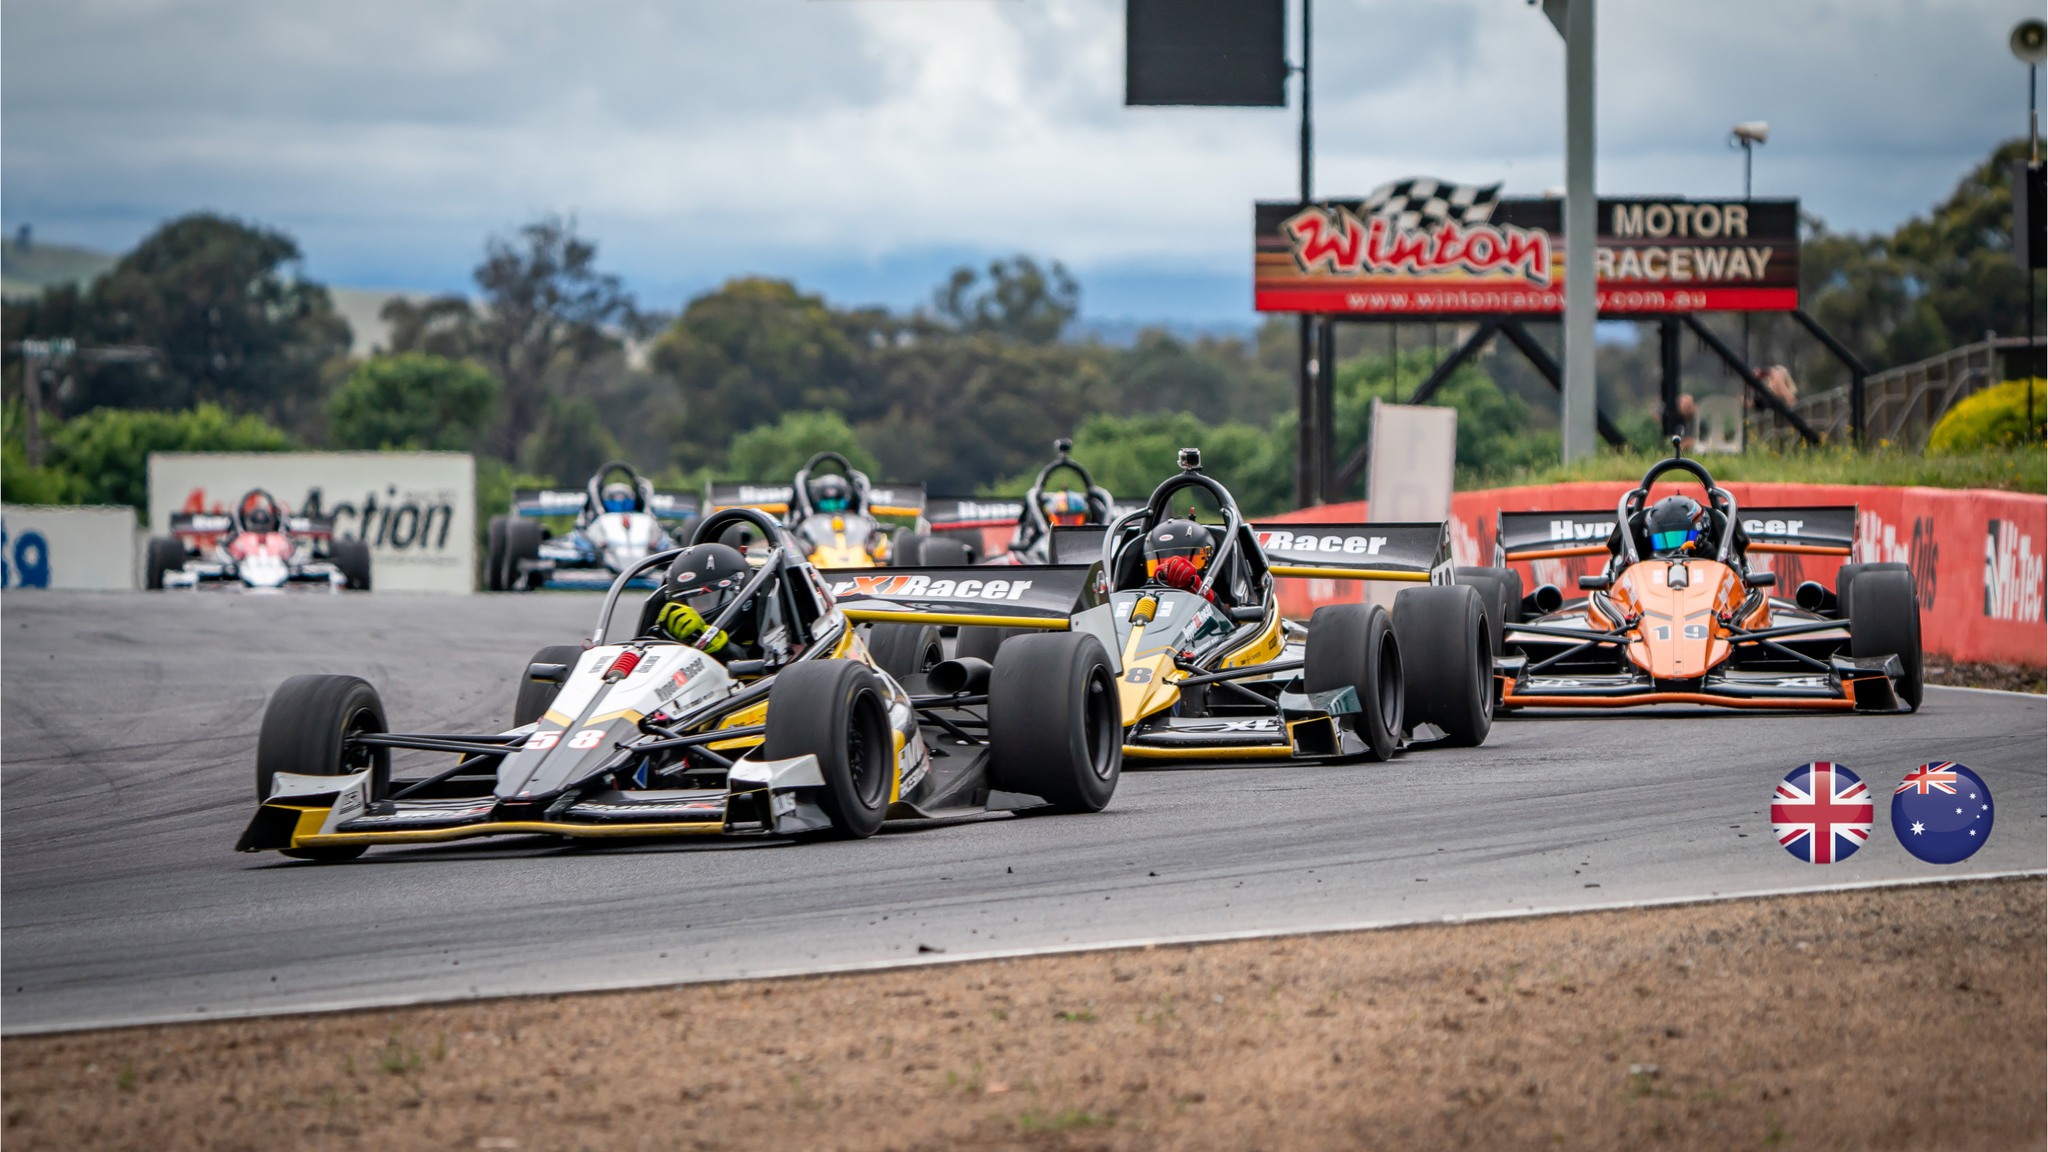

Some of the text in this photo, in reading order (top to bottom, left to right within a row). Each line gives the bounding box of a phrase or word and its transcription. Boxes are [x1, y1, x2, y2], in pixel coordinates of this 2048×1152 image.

[1612, 203, 1748, 237] MOTOR
[1283, 205, 1553, 287] Winton
[1594, 246, 1773, 281] RACEWAY
[1347, 290, 1706, 311] www.wintonracewy.com.au
[1999, 519, 2044, 624] Hi-Tec
[1652, 624, 1709, 641] 19
[1124, 667, 1154, 685] 8
[523, 729, 608, 751] 58
